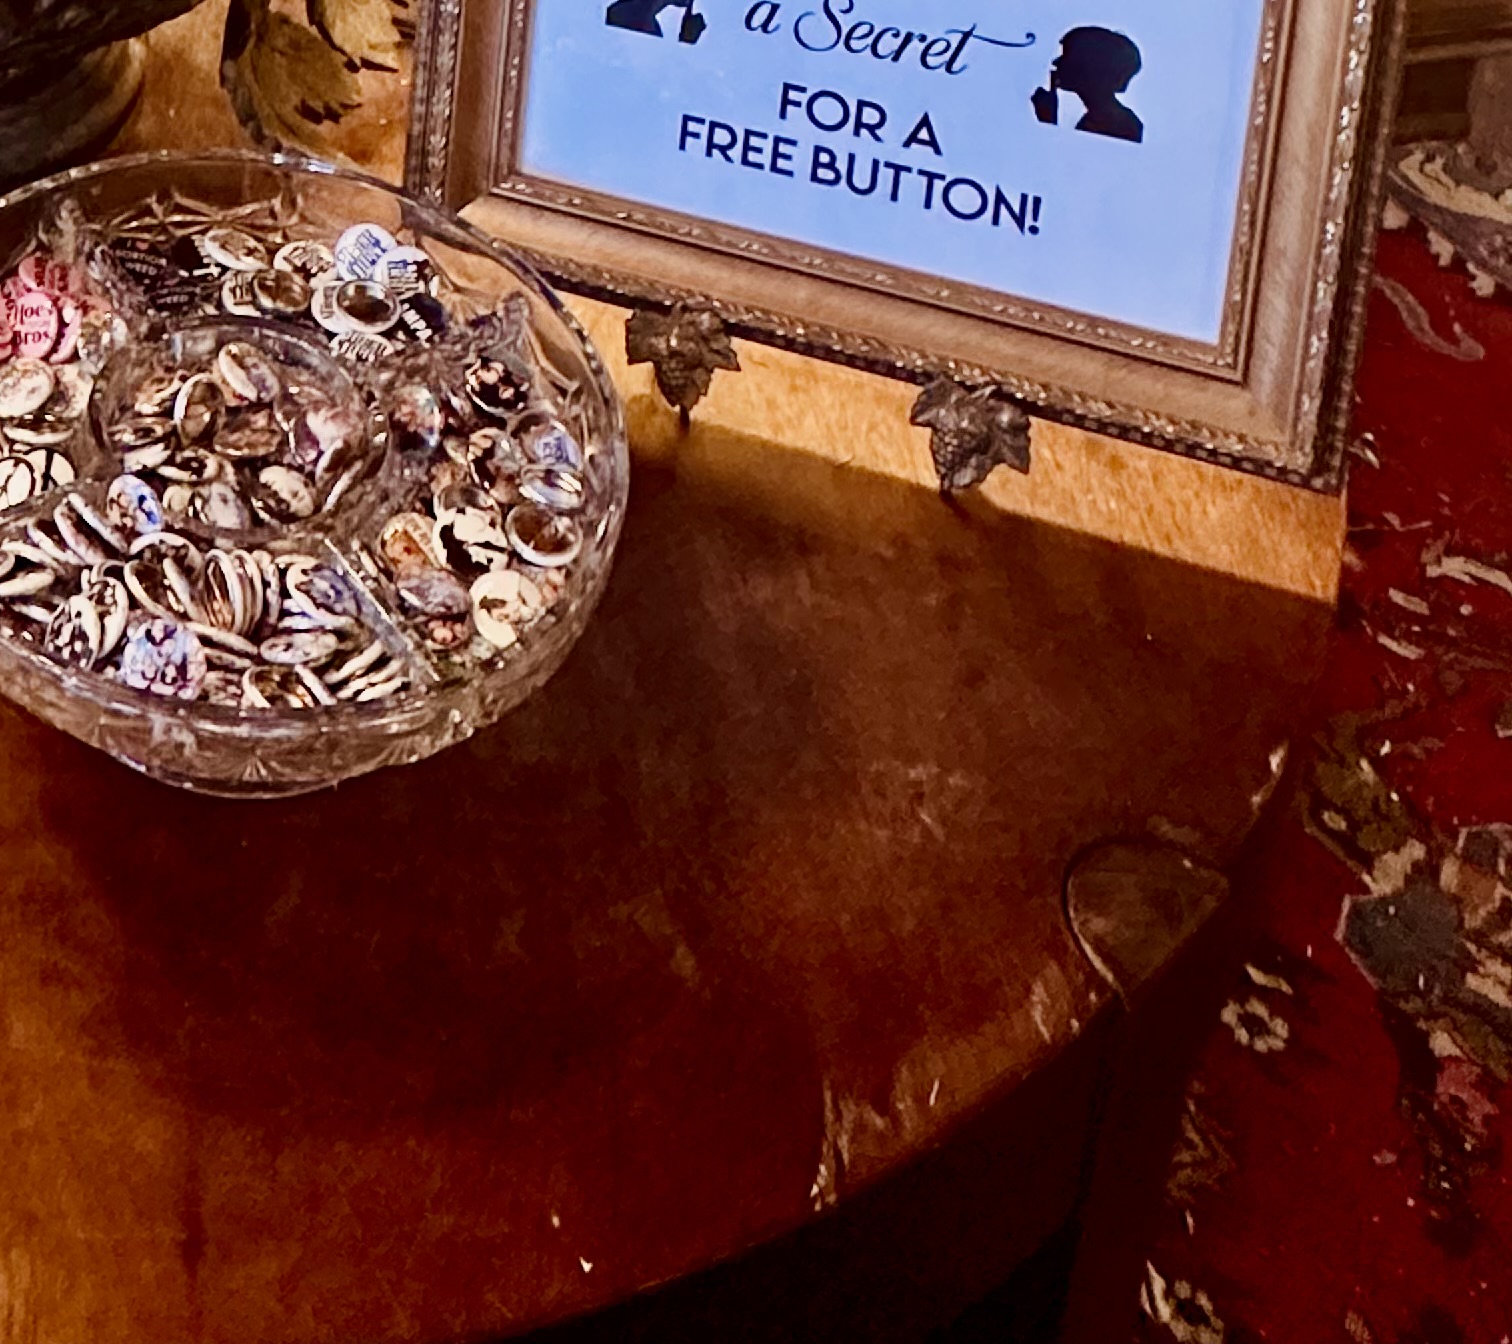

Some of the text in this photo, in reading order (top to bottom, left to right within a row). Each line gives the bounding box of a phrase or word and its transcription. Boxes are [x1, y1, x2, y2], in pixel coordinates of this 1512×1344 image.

[743, 0, 782, 35] a
[778, 81, 944, 157] FOR A
[678, 113, 1043, 236] FREE BUTTON!
